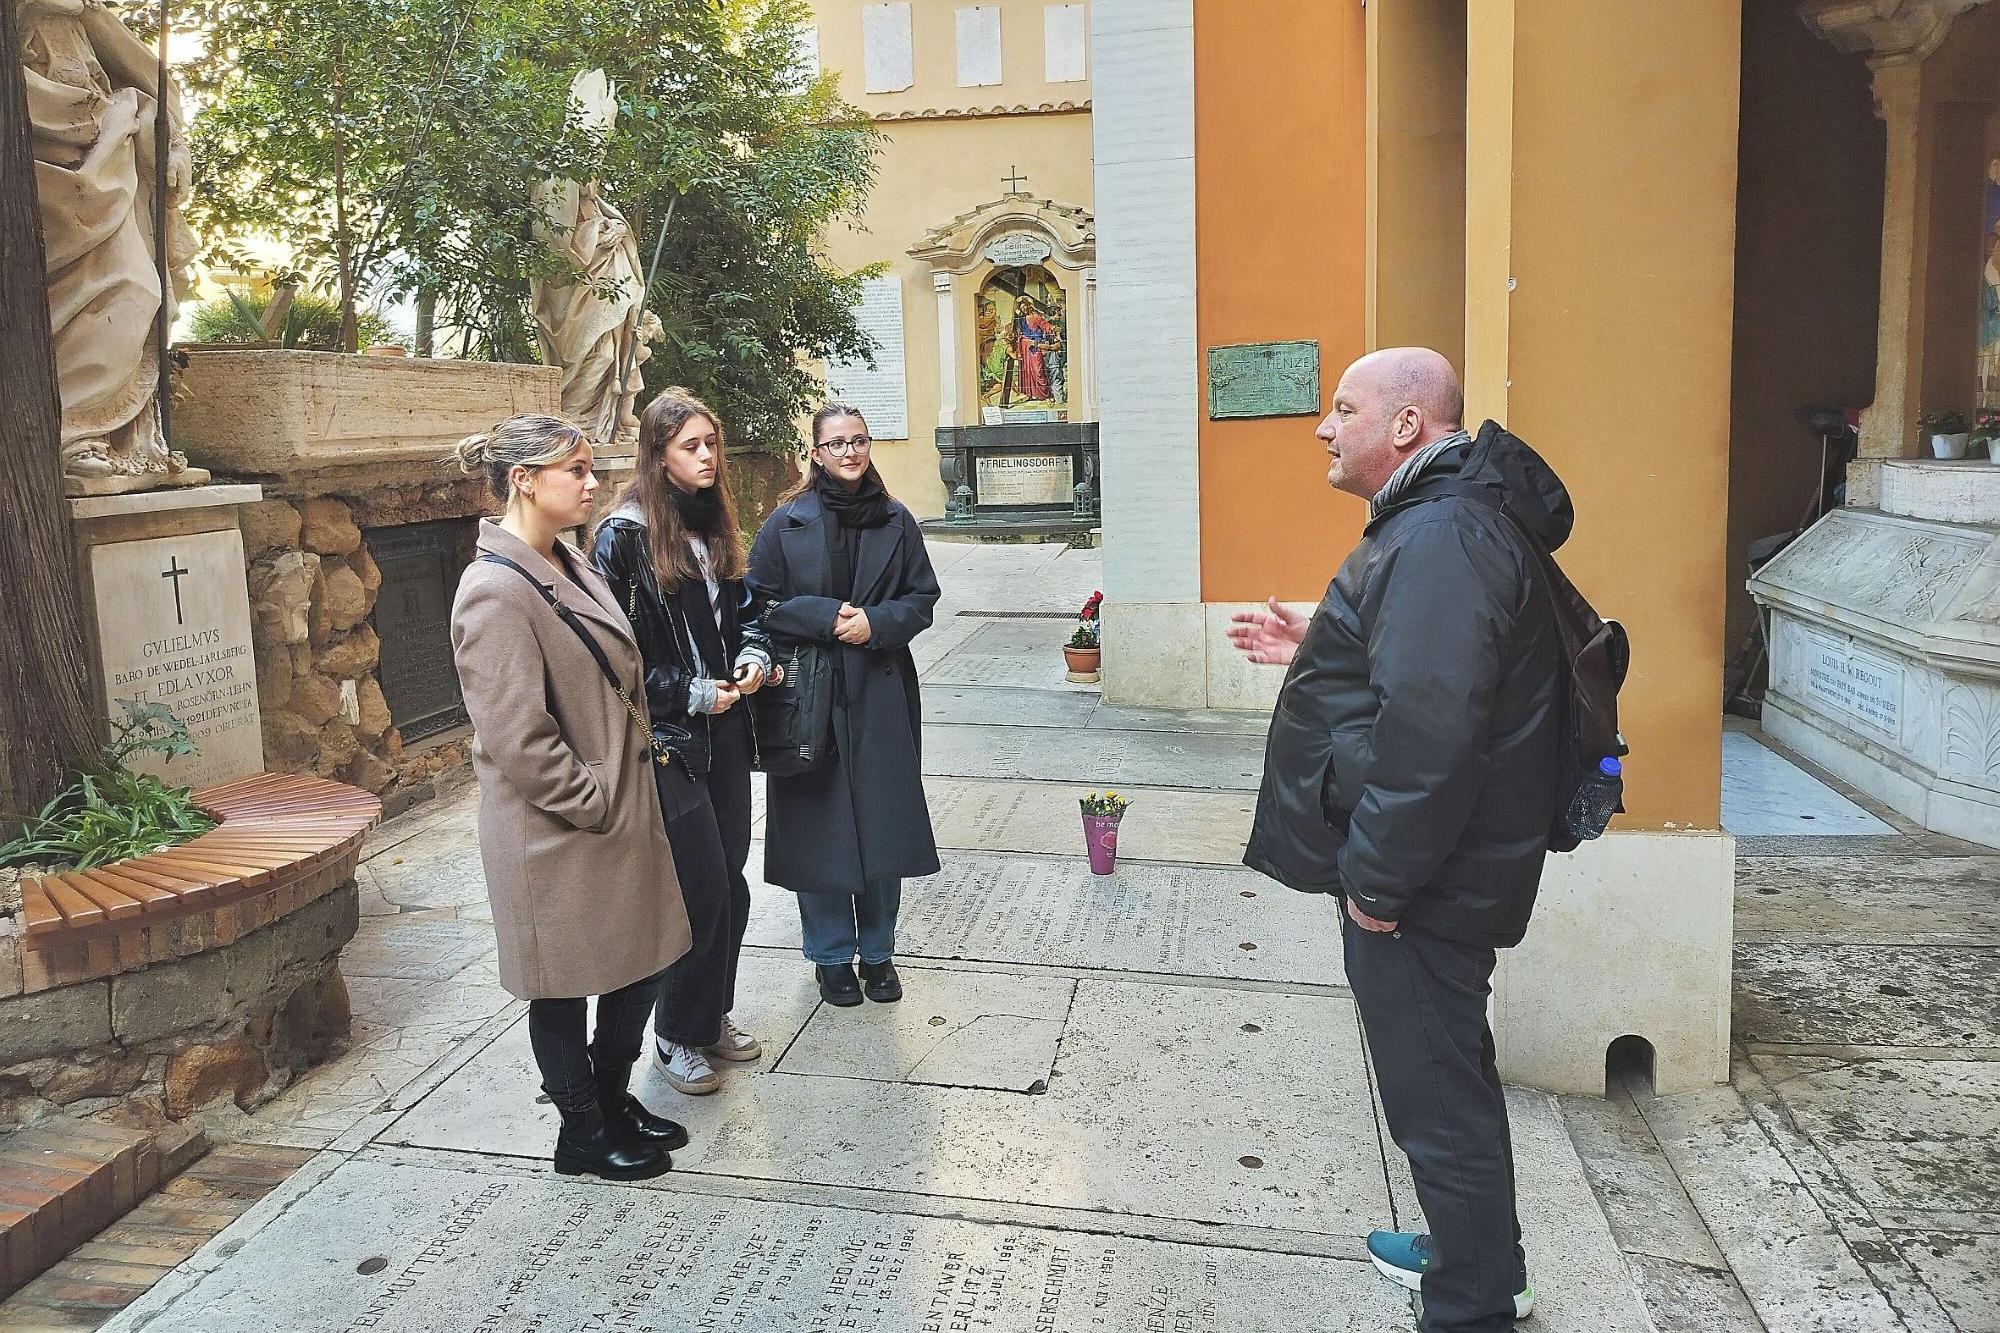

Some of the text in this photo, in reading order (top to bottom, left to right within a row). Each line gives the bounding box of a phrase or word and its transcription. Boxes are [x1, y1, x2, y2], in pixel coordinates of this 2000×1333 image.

[1267, 356, 1309, 370] HENZE
[986, 458, 1061, 468] FRIELINGSDORF
[143, 628, 220, 658] GVLIELMVS
[116, 670, 143, 686] BARO
[147, 666, 160, 678] DE
[134, 666, 234, 703] ET EDLA VXOR
[377, 1235, 460, 1299] MUTTER
[443, 1181, 509, 1234] GOTTES
[507, 1199, 598, 1293] REICHERZER
[614, 1208, 683, 1285] ROESLER
[726, 1233, 769, 1279] HENZE
[776, 1218, 822, 1286] 29 JULI 1983
[898, 1228, 916, 1251] 1984
[826, 1238, 867, 1294] HEDWIG
[988, 1269, 1006, 1294] JULI
[1205, 1261, 1217, 1286] 2001
[949, 1266, 985, 1330] ERLITZ
[1034, 1246, 1070, 1332] SERSCHMITT
